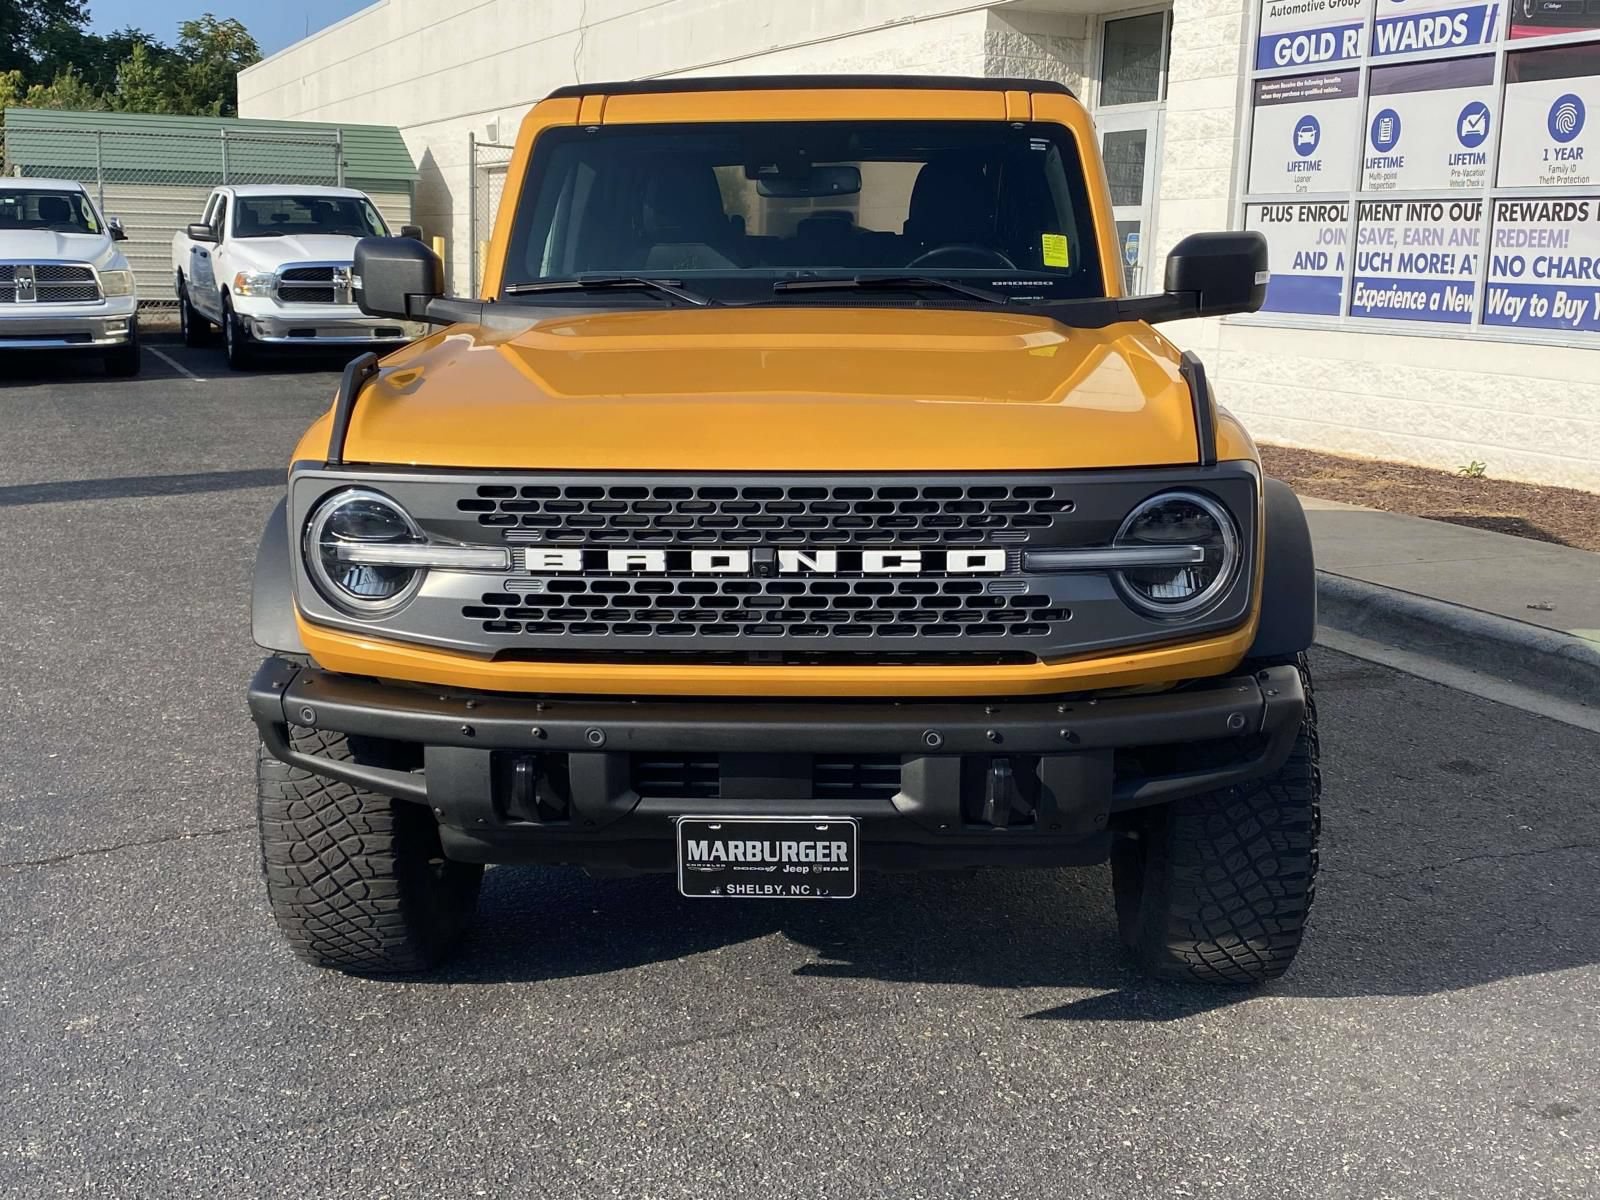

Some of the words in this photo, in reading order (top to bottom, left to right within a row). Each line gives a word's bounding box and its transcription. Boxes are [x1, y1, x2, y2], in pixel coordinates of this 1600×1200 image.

[1270, 1, 1325, 17] Automotive
[1275, 32, 1336, 66] GOLD
[1543, 148, 1549, 161] 1
[1554, 147, 1584, 161] YEAR
[1287, 160, 1322, 172] LIFETIME
[1366, 156, 1404, 169] LIFETIME
[1548, 164, 1568, 175] Family
[1539, 175, 1555, 184] Theft
[1556, 175, 1590, 184] Protection
[1261, 206, 1293, 222] PLUS
[1406, 203, 1443, 222] INTO
[1449, 202, 1483, 222] OUR
[1497, 201, 1589, 222] REWARDS
[1359, 227, 1397, 249] SAVE,
[1403, 228, 1444, 246] EARN
[1448, 228, 1481, 247] AND
[1496, 228, 1570, 248] REDEEM!
[1293, 251, 1328, 271] AND
[1398, 253, 1456, 275] MORE!
[1492, 255, 1526, 278] NO
[1354, 282, 1427, 313] Experience
[1430, 291, 1441, 311] a
[1442, 286, 1473, 313] New
[1488, 288, 1527, 323] Way
[1529, 293, 1548, 318] to
[1552, 291, 1589, 326] Buy
[525, 547, 1006, 572] BRONCO
[687, 840, 848, 862] MARBURGER
[783, 865, 809, 873] Jeep
[727, 884, 786, 896] SHELBY,
[791, 884, 810, 895] NC
